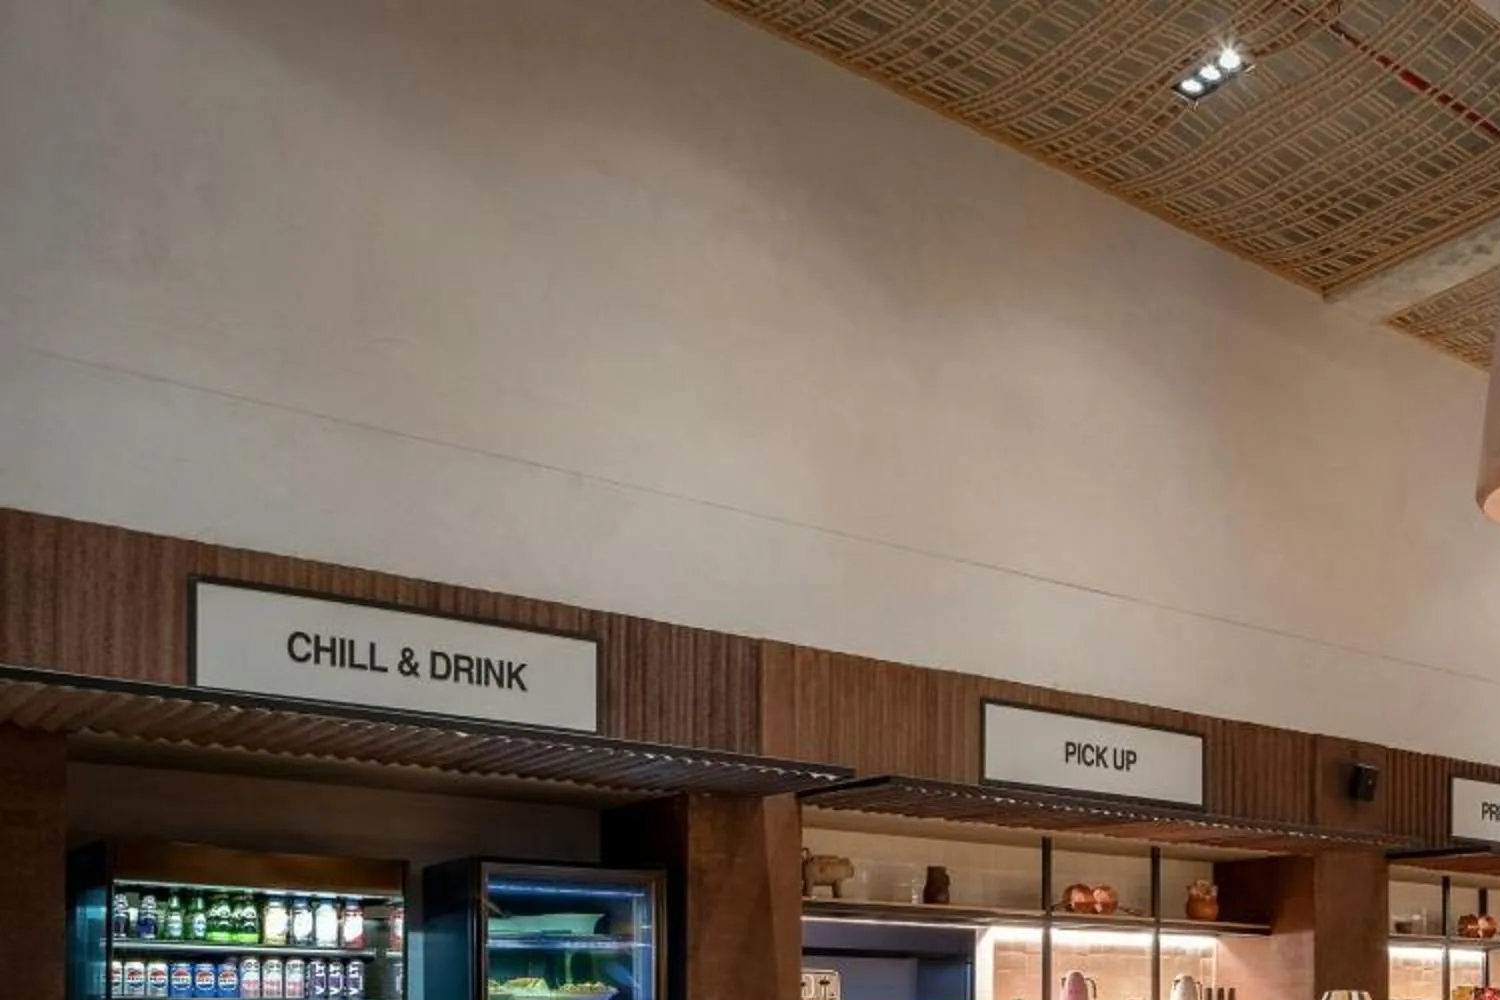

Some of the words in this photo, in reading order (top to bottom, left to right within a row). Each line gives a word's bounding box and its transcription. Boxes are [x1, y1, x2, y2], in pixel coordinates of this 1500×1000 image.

[287, 631, 388, 673] CHILL
[397, 647, 420, 678] &
[429, 650, 528, 692] DRINK
[1064, 741, 1108, 769] PICK
[1112, 748, 1138, 772] UP
[314, 962, 325, 995] VLT
[329, 963, 341, 995] VLT
[348, 963, 360, 995] VLT
